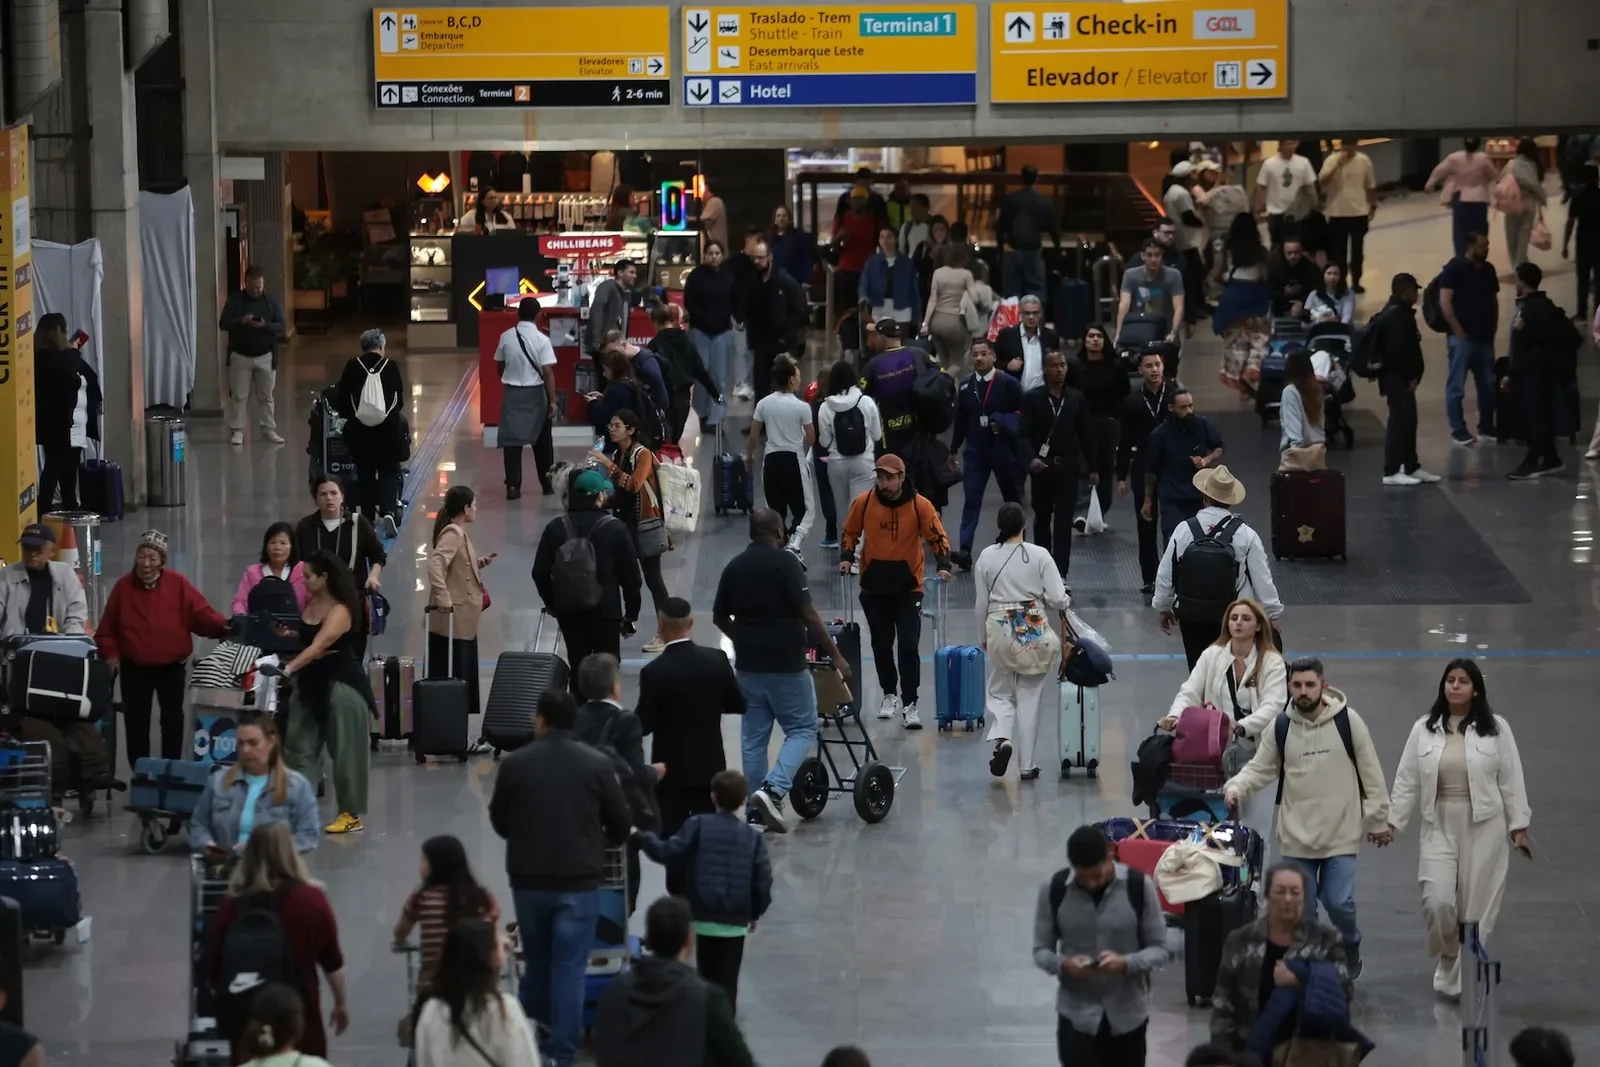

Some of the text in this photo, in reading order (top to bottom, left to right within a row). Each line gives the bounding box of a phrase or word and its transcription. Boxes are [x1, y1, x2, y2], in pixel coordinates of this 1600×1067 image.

[446, 16, 482, 29] B,C,D
[750, 12, 806, 24] Traslado
[818, 12, 851, 24] Trem
[863, 14, 952, 34] Terminal 1
[1076, 13, 1178, 36] Check-in
[420, 31, 464, 42] Embarque
[750, 27, 799, 40] Shuttle
[812, 27, 843, 40] Train
[420, 41, 464, 51] Departure
[749, 45, 865, 58] Desembarque Leste
[578, 56, 625, 67] Elevadores
[749, 59, 820, 71] East arrivals
[578, 67, 614, 76] Elevator
[1027, 66, 1119, 87] Elevador
[1137, 68, 1209, 85] Elevator
[420, 83, 464, 94] Conexões
[478, 88, 513, 98] Terminal
[517, 87, 527, 100] 2
[626, 88, 664, 99] 2-6 min
[750, 83, 792, 99] Hotel
[420, 93, 475, 104] Connections
[546, 238, 614, 250] CHILLIBEANS
